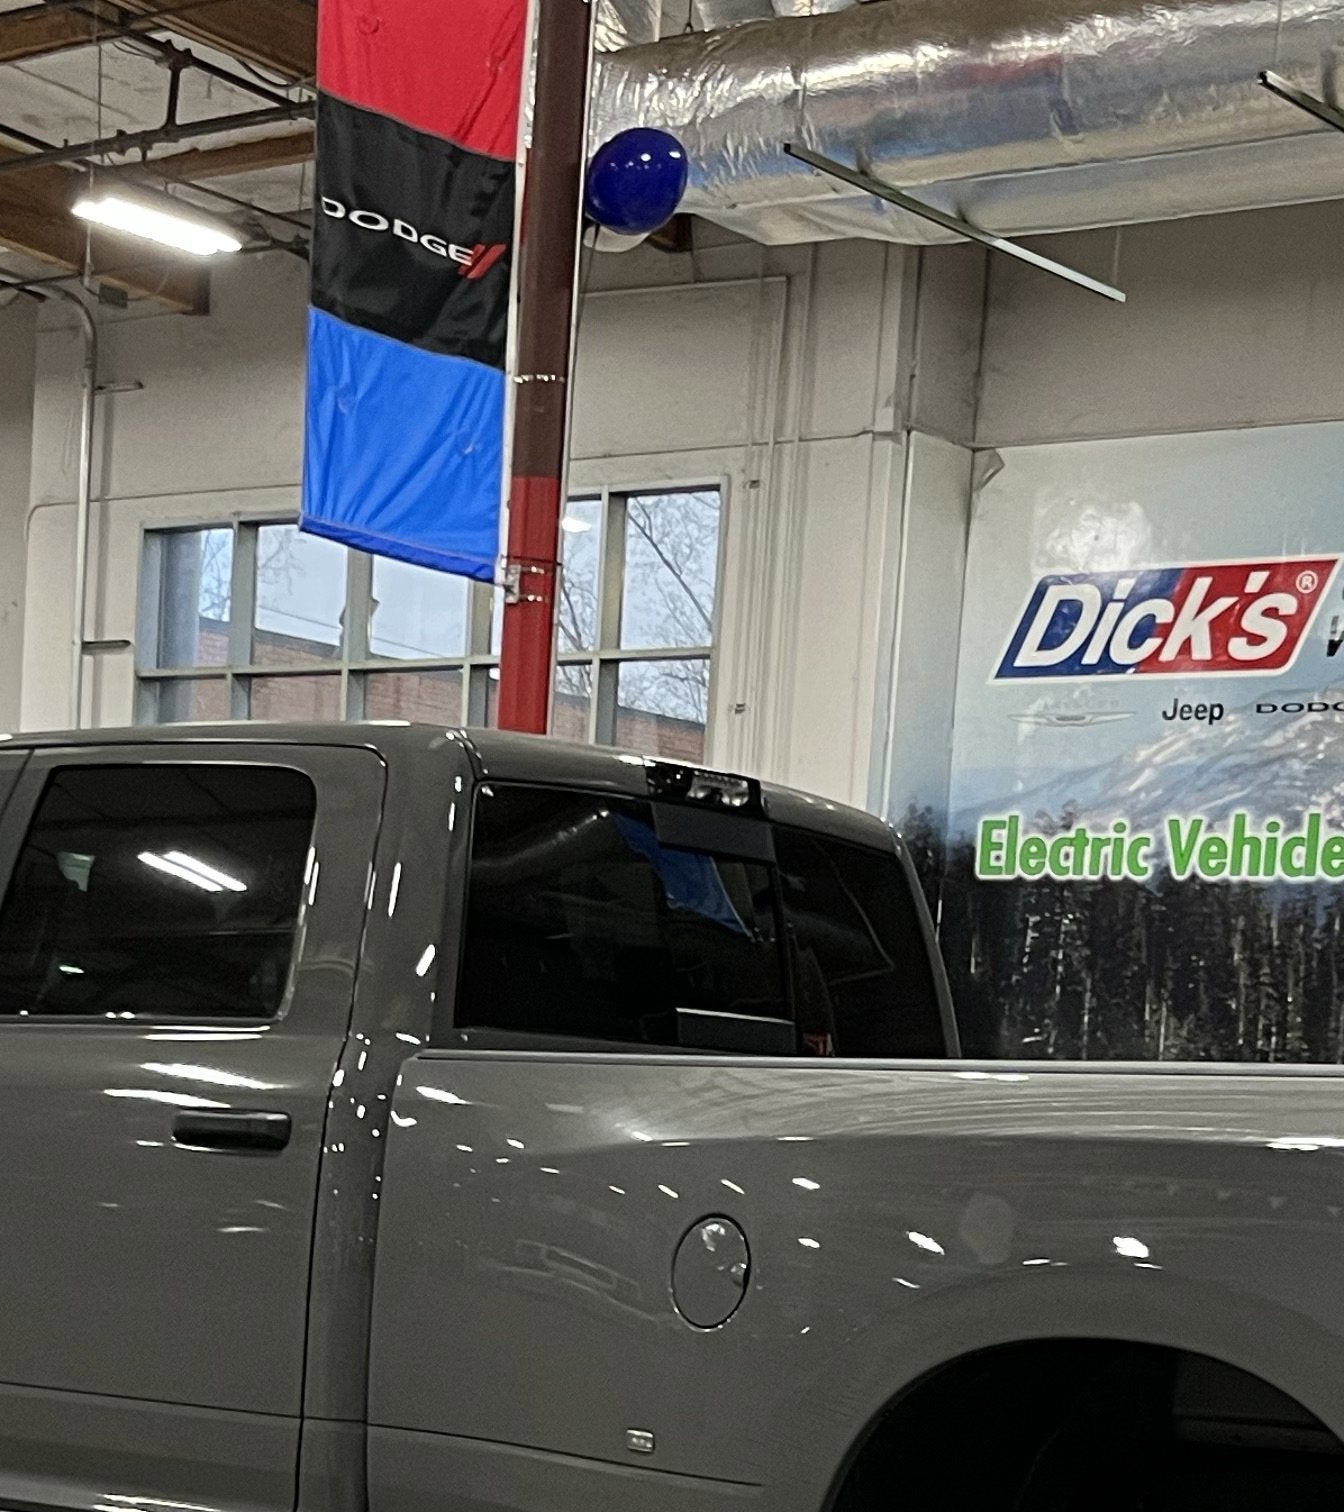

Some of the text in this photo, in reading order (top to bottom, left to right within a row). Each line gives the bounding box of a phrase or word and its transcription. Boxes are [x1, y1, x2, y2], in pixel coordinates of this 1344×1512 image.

[321, 196, 474, 266] DODGE
[1013, 571, 1298, 667] Dick's
[1162, 698, 1224, 725] Jeep
[979, 815, 1150, 876] Electric
